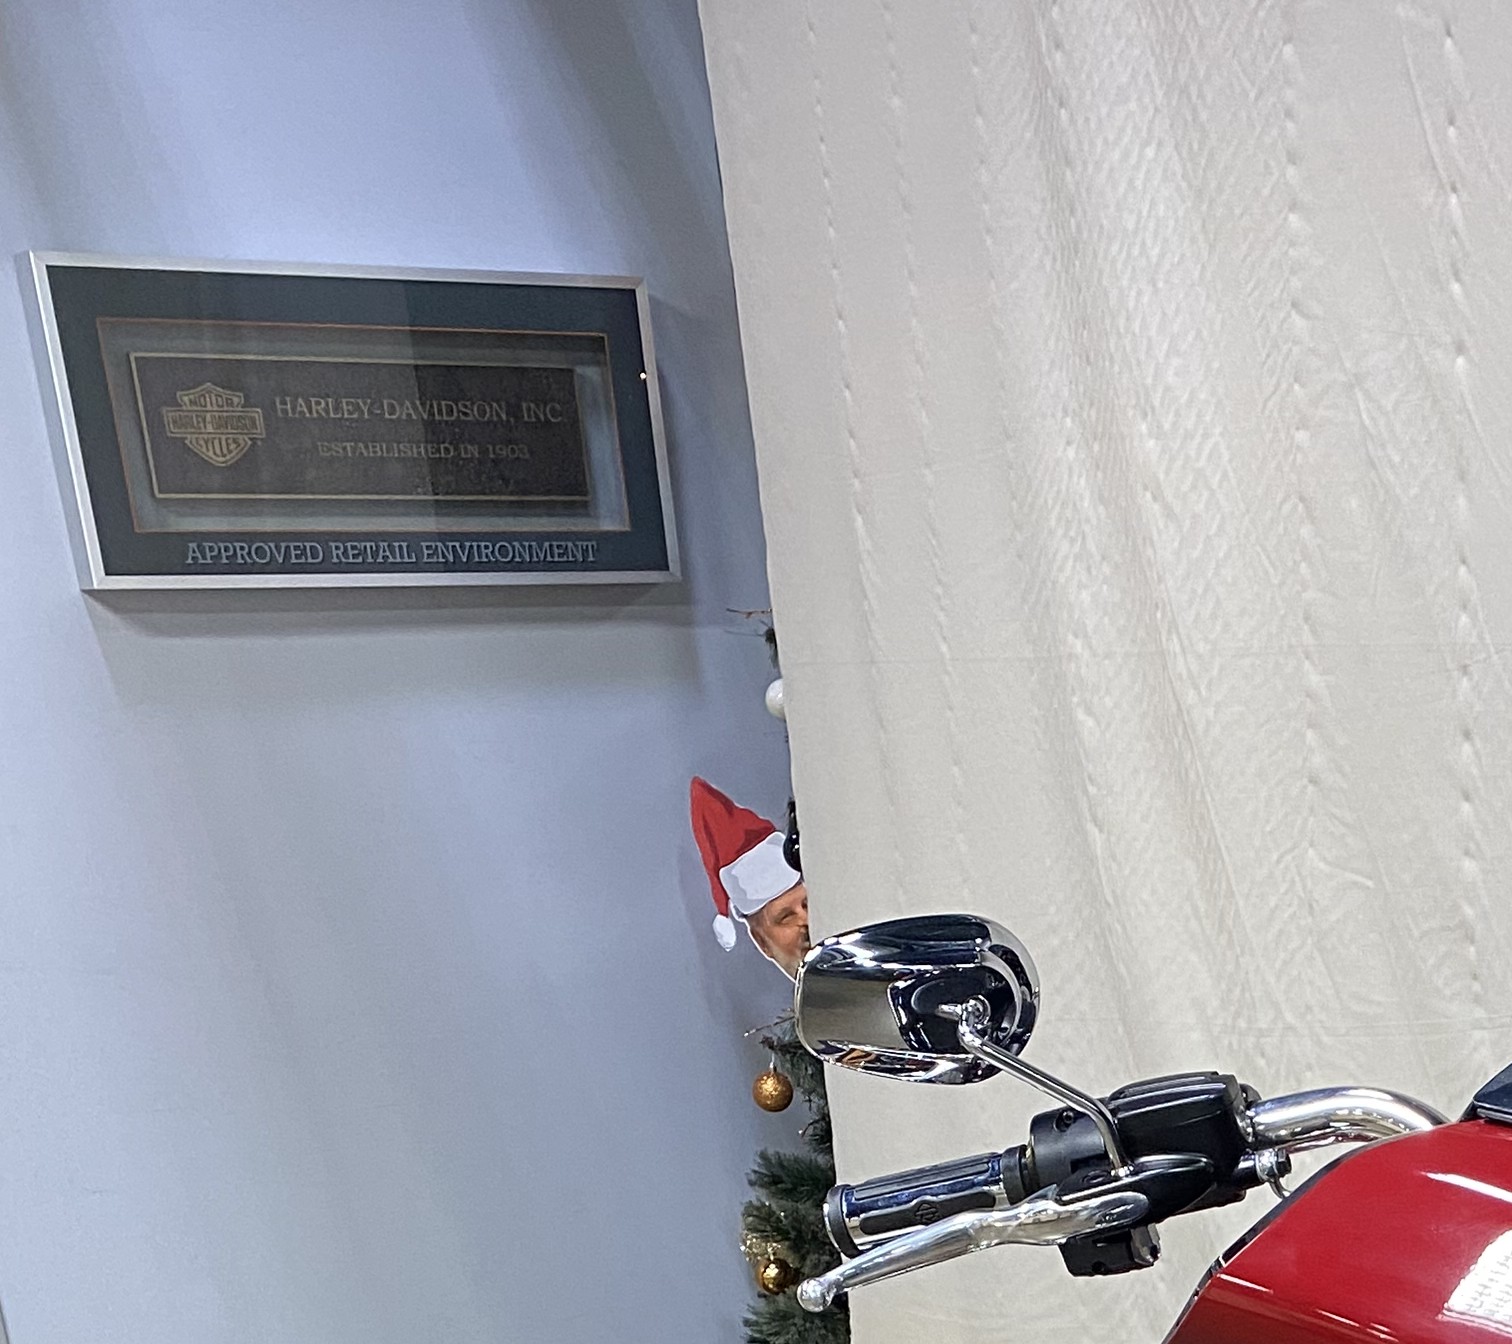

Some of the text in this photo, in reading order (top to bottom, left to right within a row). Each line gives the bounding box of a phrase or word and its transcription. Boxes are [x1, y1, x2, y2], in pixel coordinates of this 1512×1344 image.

[316, 441, 530, 460] ESTABLISHED IN 1903
[185, 541, 598, 564] APPROVED RETAIL ENVIRONMENT
